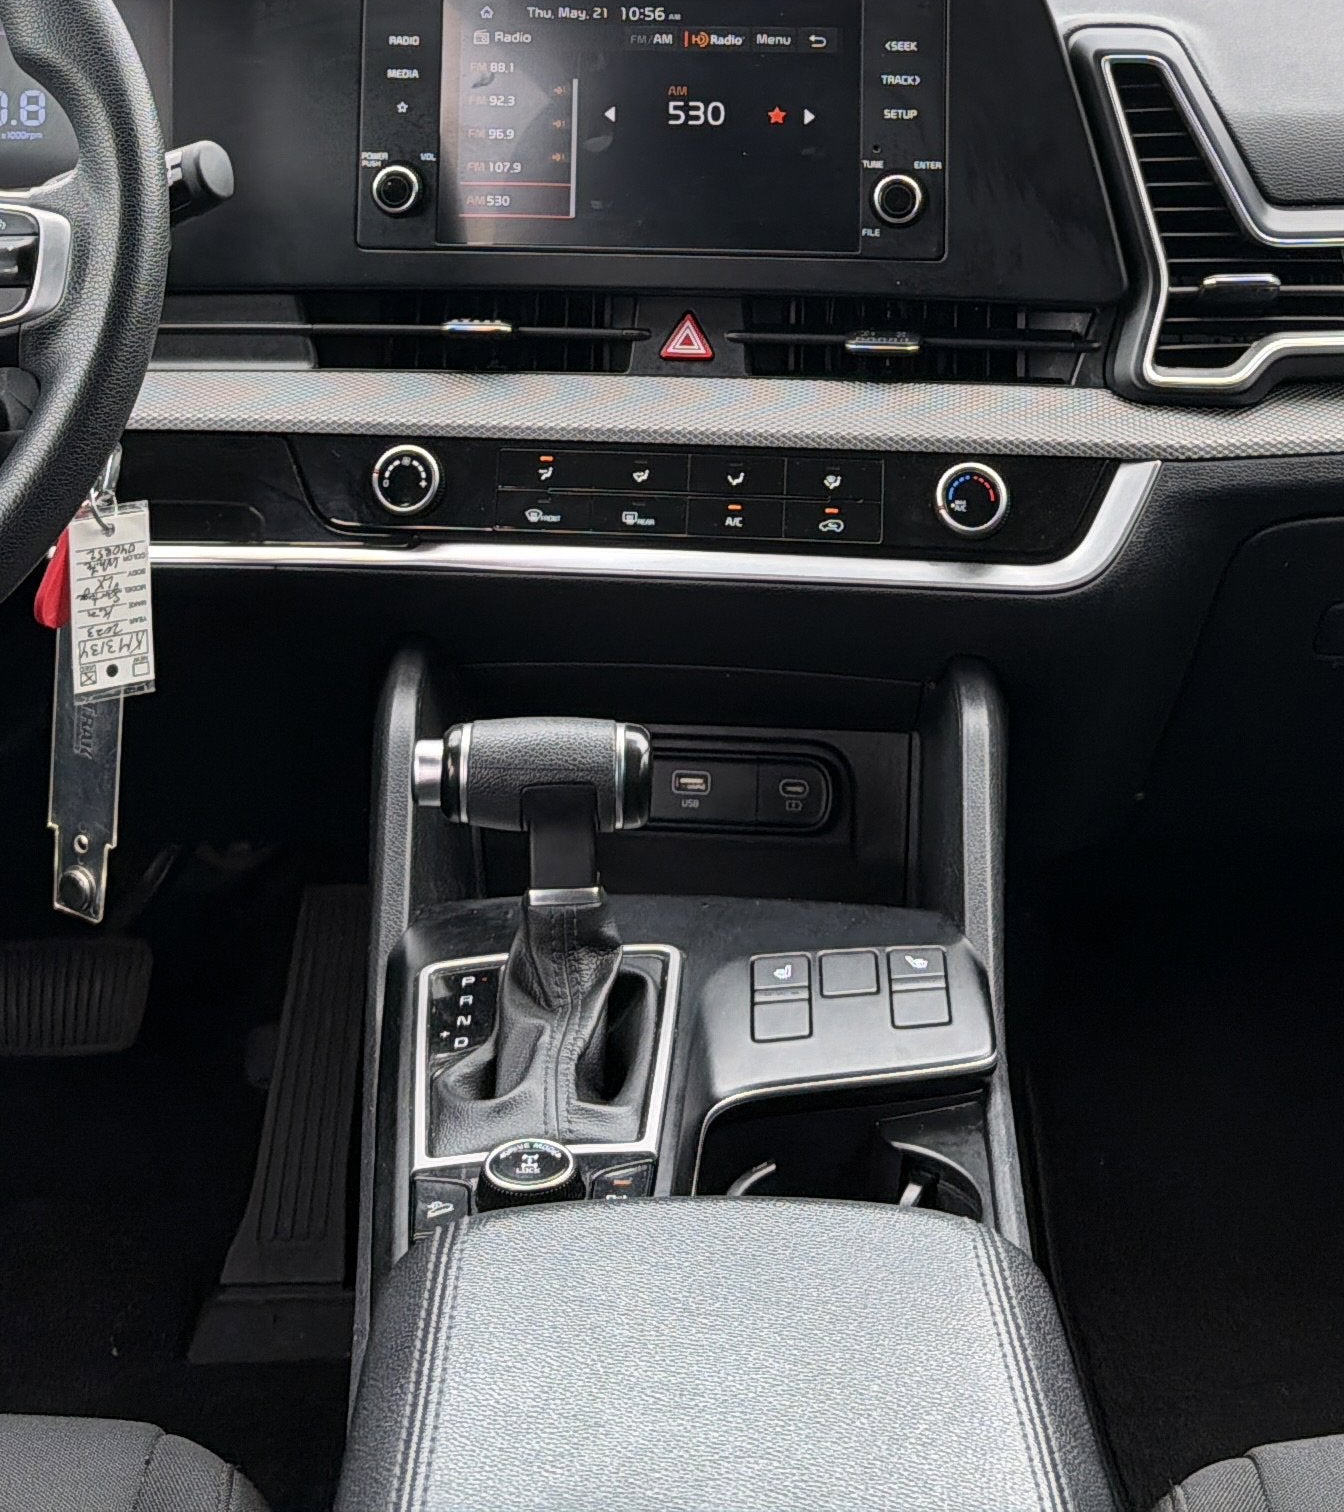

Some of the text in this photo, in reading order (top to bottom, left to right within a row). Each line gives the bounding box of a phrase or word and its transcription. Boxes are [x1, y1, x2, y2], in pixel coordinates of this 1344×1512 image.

[592, 7, 608, 19] 21
[620, 6, 681, 21] 10:56 AM
[389, 36, 420, 46] RADIO
[494, 31, 532, 43] Radio
[630, 33, 673, 45] FM/AM
[756, 34, 792, 46] Menu
[469, 62, 514, 73] FM 88.1
[387, 69, 419, 79] MEDIA
[667, 85, 688, 96] AM
[468, 96, 515, 106] FM 92.3
[667, 101, 726, 126] 530
[883, 109, 918, 119] SETUP
[468, 128, 515, 139] FM 96.9
[361, 151, 388, 161] POWER
[420, 153, 437, 161] VOL
[361, 160, 382, 168] PUSH
[466, 162, 522, 173] FM 107.9
[861, 160, 884, 169] TUNE
[913, 160, 942, 169] ENTER
[466, 196, 510, 206] AM 530
[862, 228, 881, 237] FILE
[725, 516, 743, 527] A/C
[86, 623, 122, 638] 2023
[681, 799, 699, 808] USB
[461, 975, 476, 988] P
[456, 1014, 472, 1028] N
[453, 1036, 469, 1049] D
